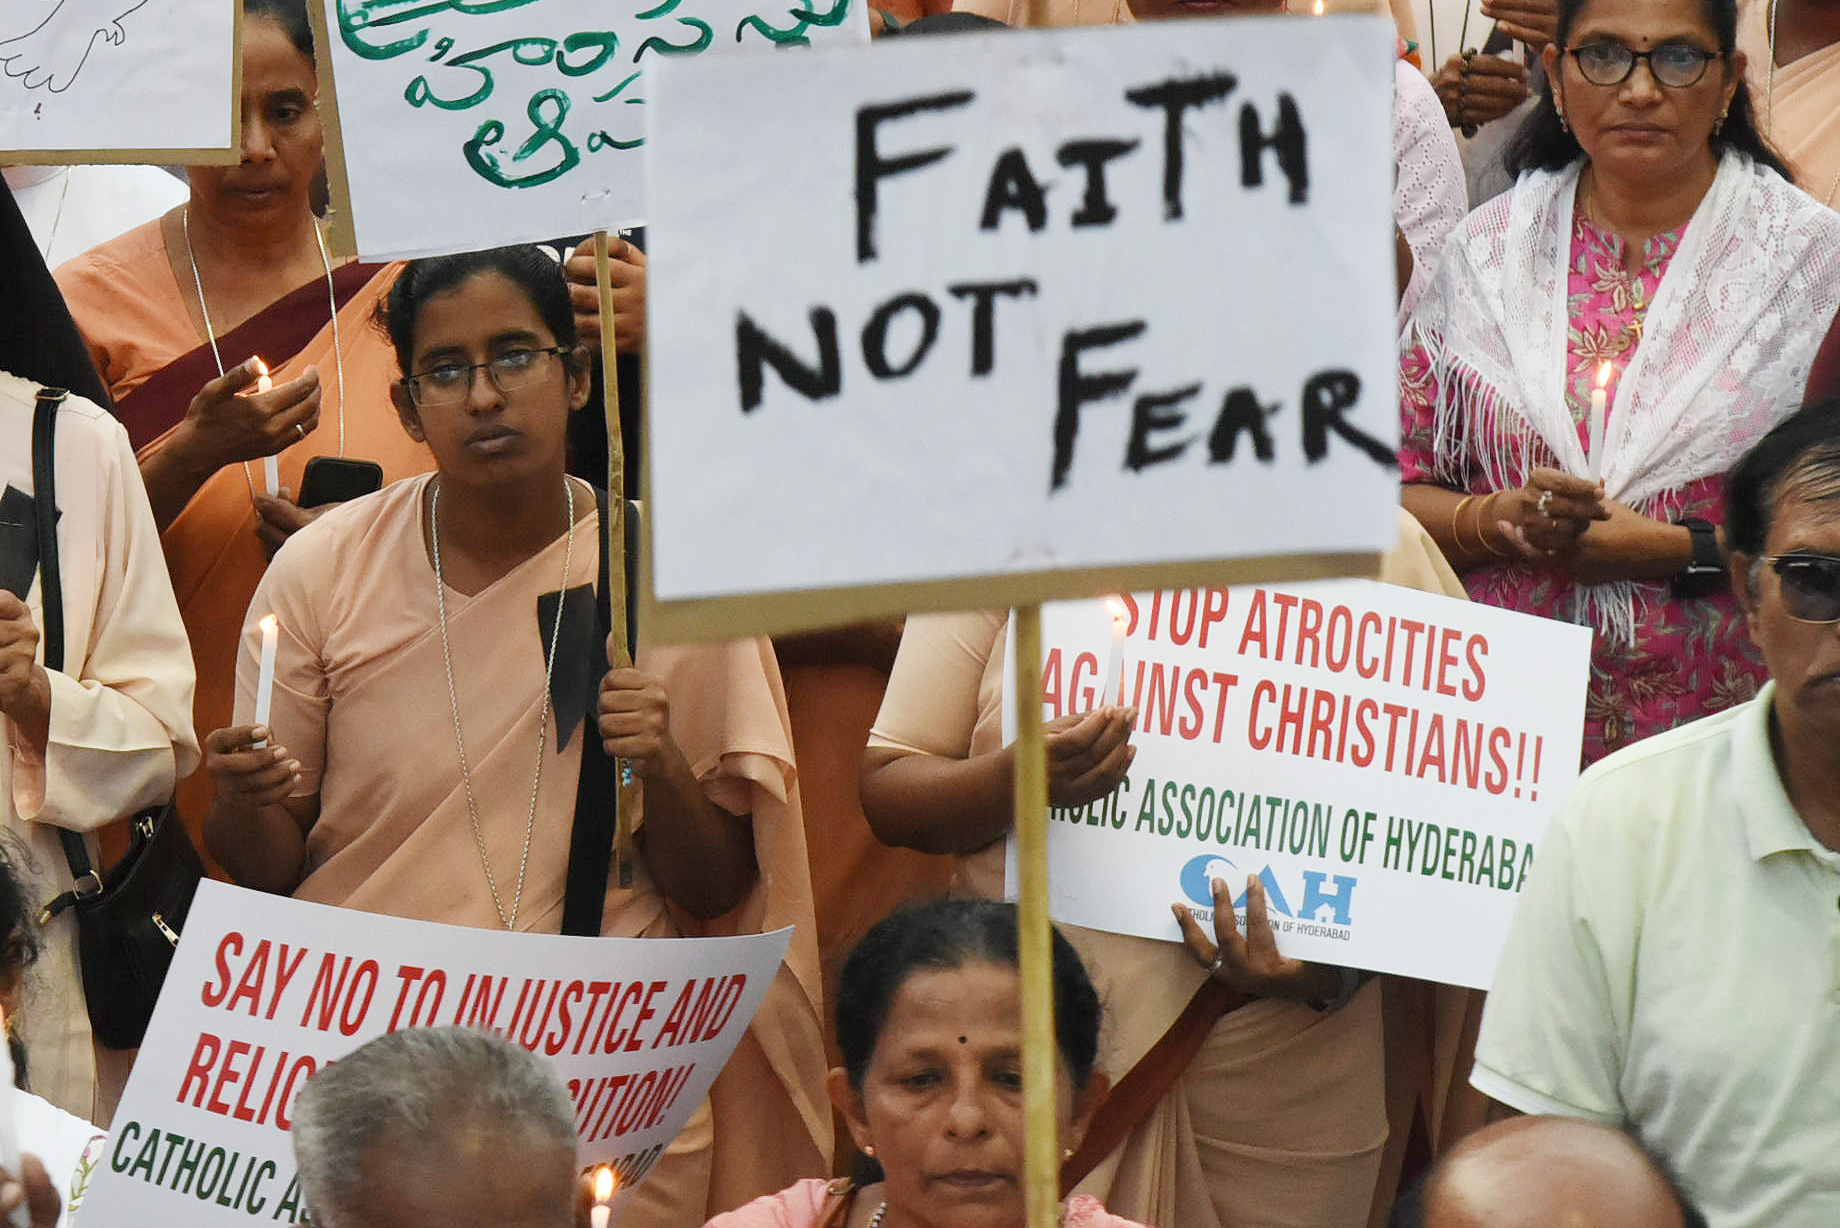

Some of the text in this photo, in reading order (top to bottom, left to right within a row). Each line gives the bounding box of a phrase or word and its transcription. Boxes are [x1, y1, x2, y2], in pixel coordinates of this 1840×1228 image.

[852, 71, 1312, 264] FAITH
[734, 278, 1039, 416] NOT
[1047, 318, 1401, 496] FEAR
[1237, 588, 1490, 702] ATROCITIES
[1247, 678, 1544, 803] CHRISTIANS!!
[1049, 776, 1534, 893] HOLIC ASSOCIATION OF HYDERABA
[1297, 923, 1351, 942] HYDERABAD
[201, 930, 748, 1058] SAY NO TO INJUSTICE AND
[176, 1032, 317, 1132] RELIG
[111, 1121, 277, 1215] CATHOLIC
